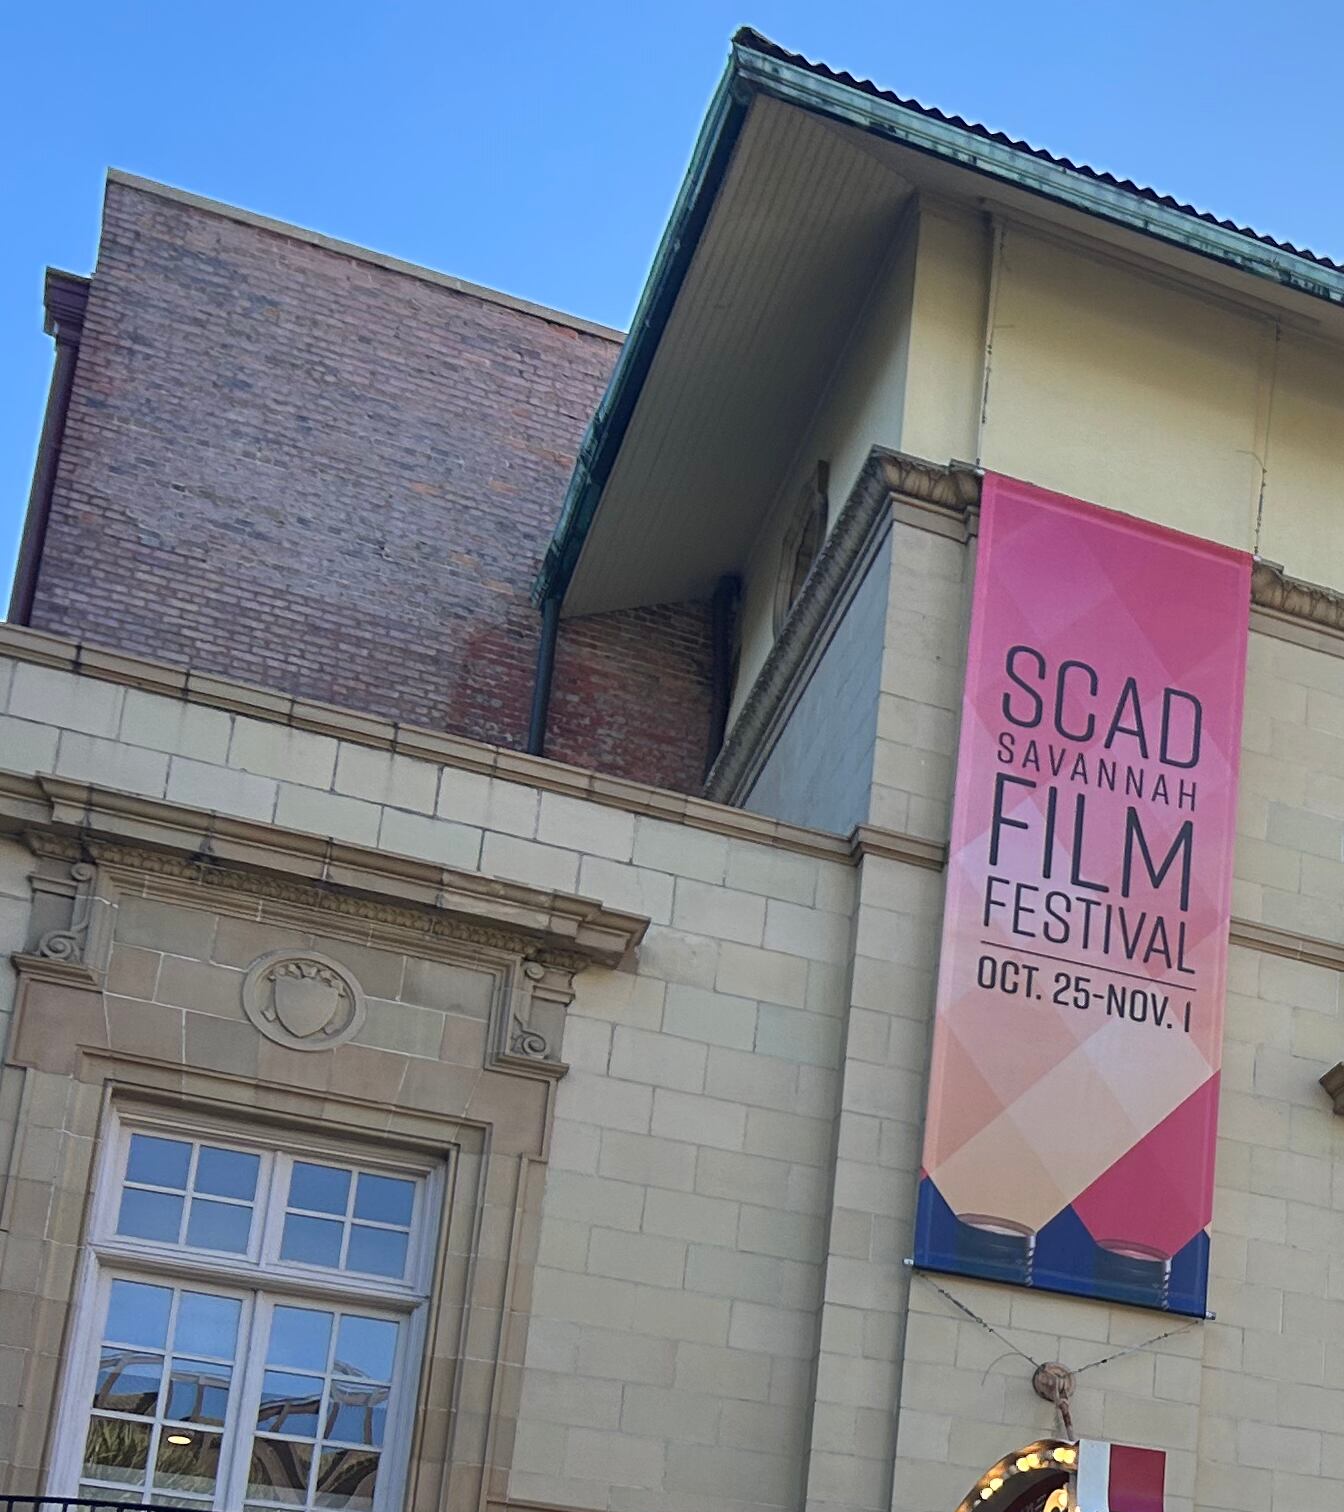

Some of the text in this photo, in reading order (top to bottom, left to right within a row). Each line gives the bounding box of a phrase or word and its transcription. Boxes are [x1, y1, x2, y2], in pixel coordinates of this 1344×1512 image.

[1002, 645, 1202, 769] SCAD
[997, 732, 1196, 812] SAVANNAH
[988, 773, 1195, 912] FILM
[983, 875, 1196, 974] FESTIVAL
[977, 955, 1042, 1000] OCT.
[1052, 972, 1173, 1029] 25-NOV.
